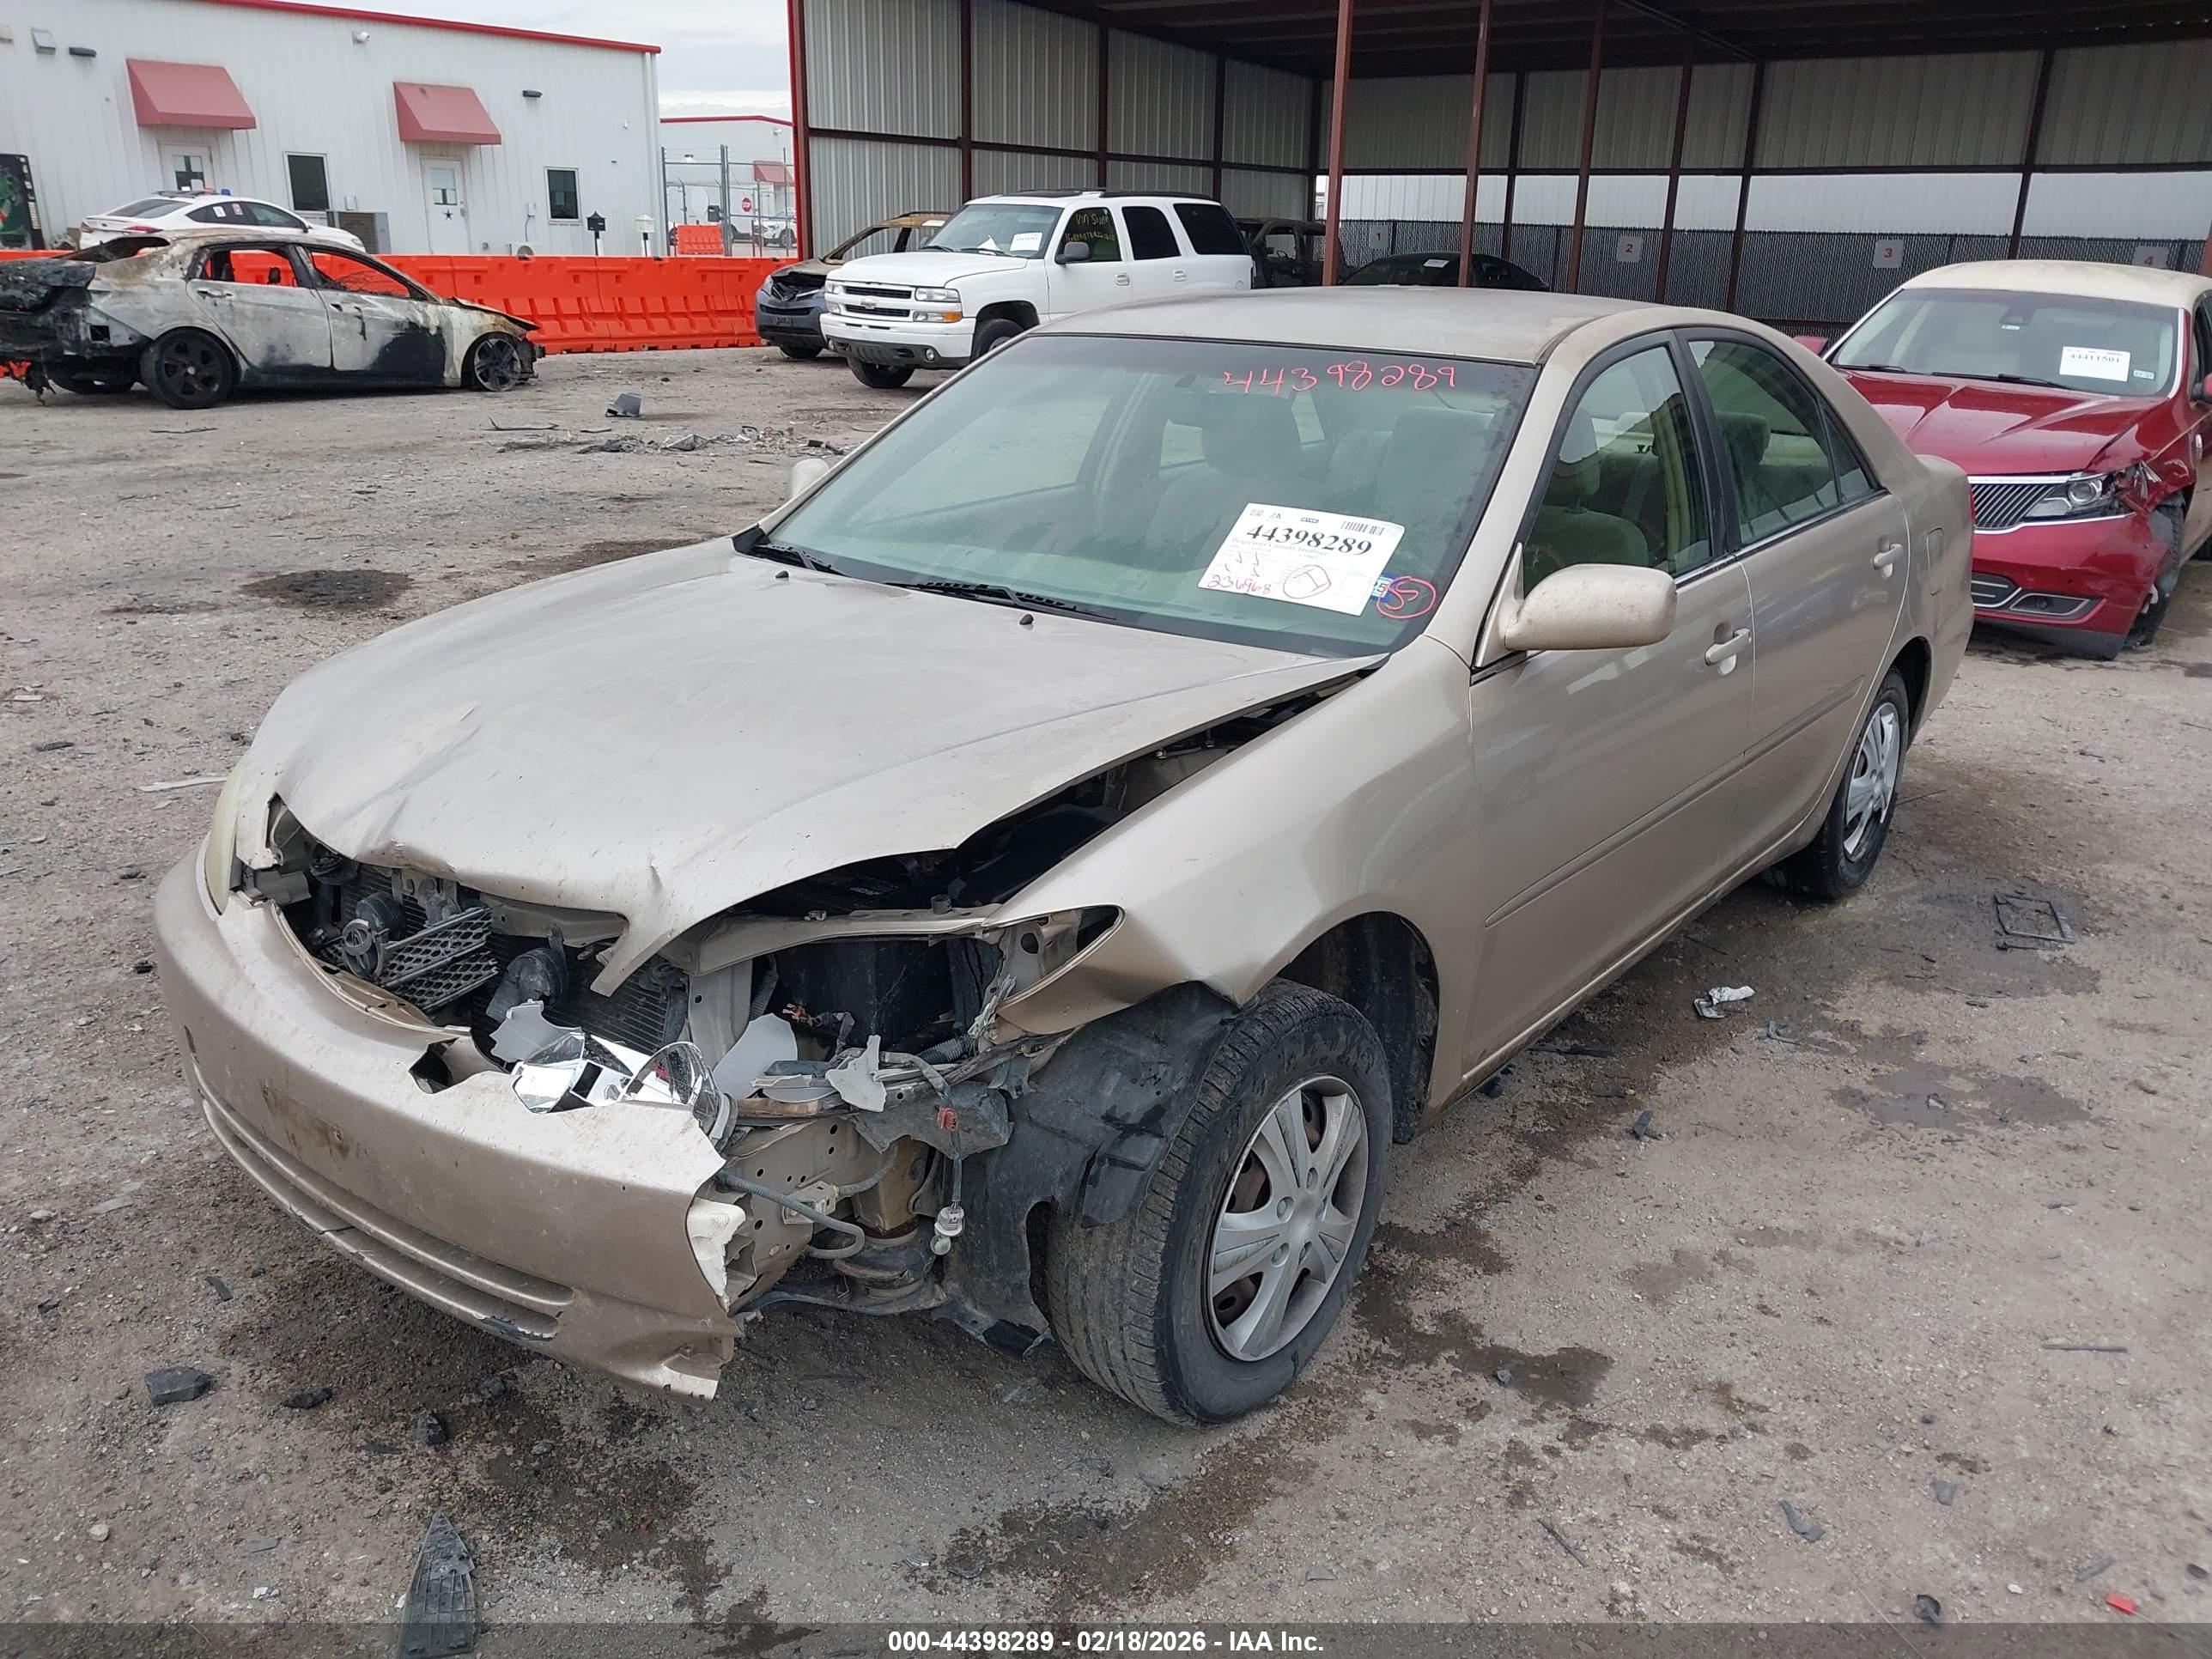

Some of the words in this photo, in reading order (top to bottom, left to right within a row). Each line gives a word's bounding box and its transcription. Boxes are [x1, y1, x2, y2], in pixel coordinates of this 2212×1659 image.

[1376, 233, 1382, 241] 1
[1625, 243, 1634, 253] 2
[1883, 247, 1893, 258] 3
[2143, 255, 2154, 266] 4
[2069, 353, 2120, 364] 44411501
[1224, 360, 1457, 395] 44398289
[1246, 523, 1372, 556] 44398289
